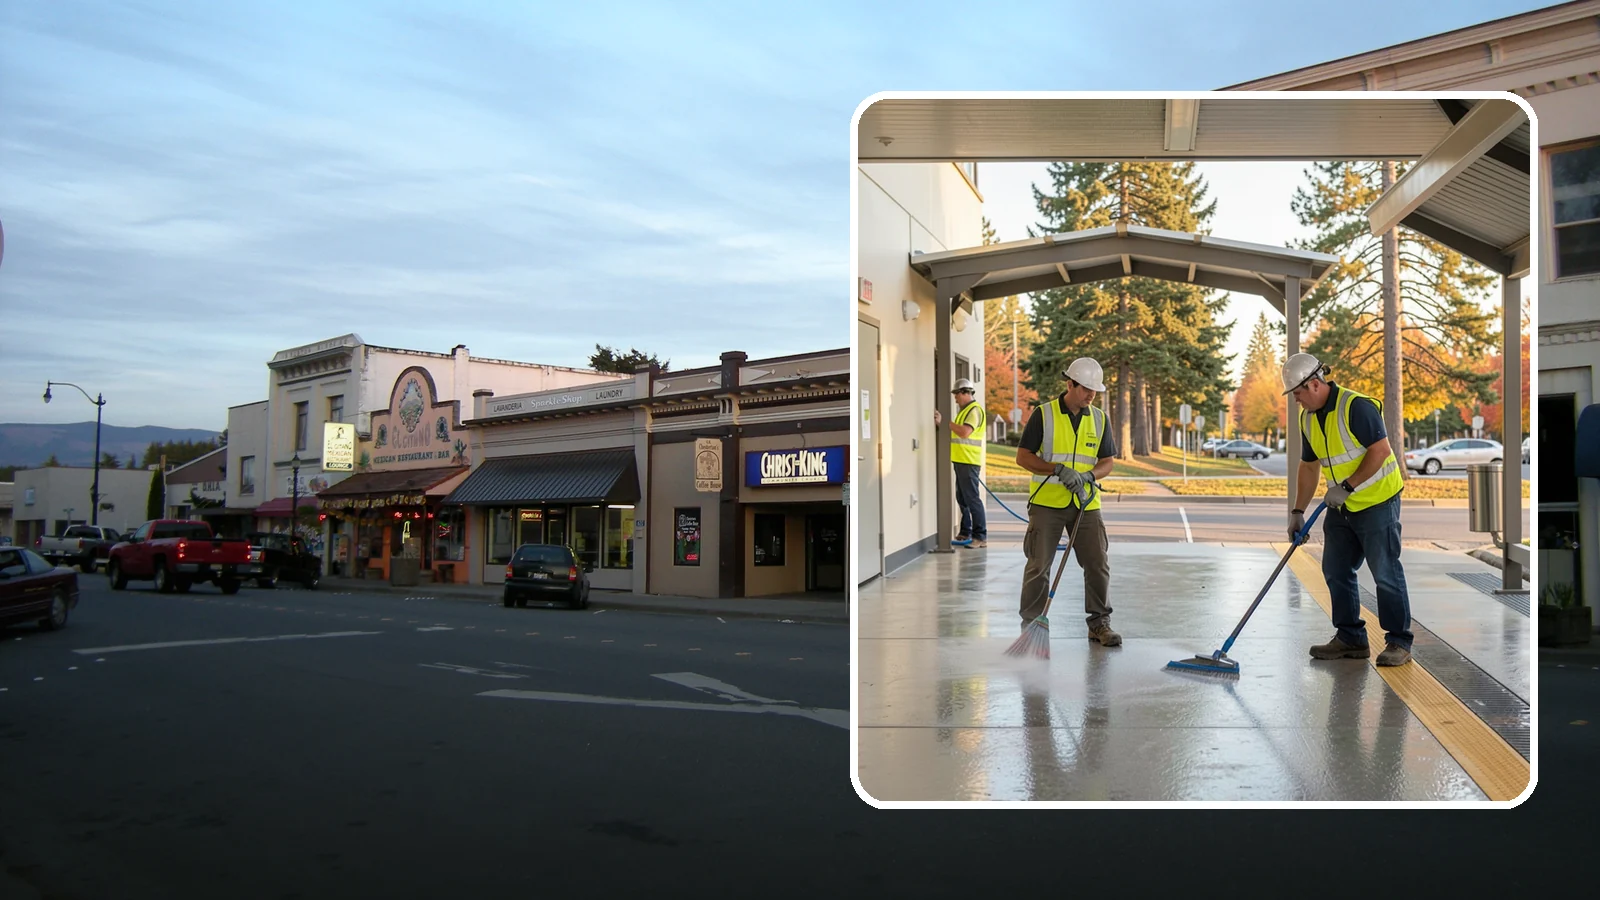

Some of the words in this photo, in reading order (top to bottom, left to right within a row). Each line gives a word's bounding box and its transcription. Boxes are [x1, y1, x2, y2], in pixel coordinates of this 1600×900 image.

[493, 402, 522, 412] LAVANDERIA
[562, 394, 582, 405] Shop
[595, 389, 623, 400] LAUNDRY
[397, 451, 434, 463] RESTAURANT
[438, 450, 450, 459] BAR
[760, 452, 797, 478] CHRIST
[799, 450, 827, 476] KING
